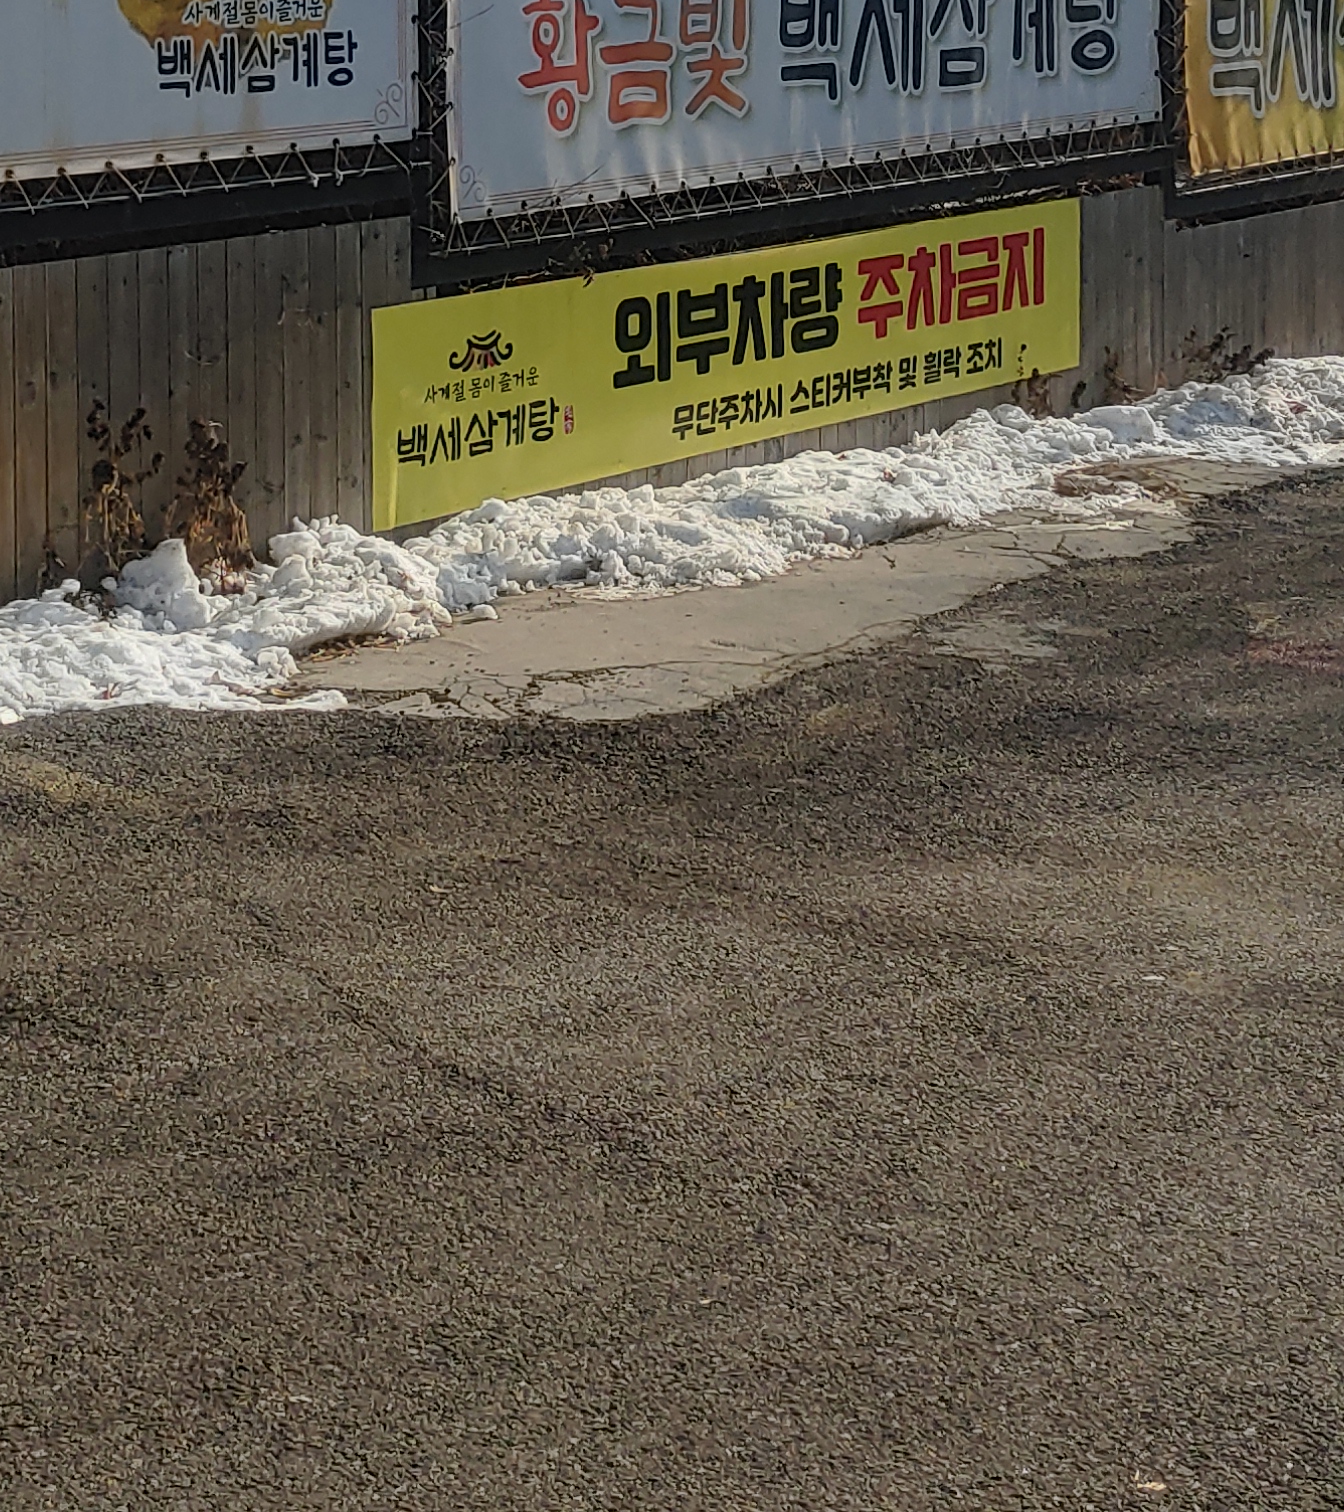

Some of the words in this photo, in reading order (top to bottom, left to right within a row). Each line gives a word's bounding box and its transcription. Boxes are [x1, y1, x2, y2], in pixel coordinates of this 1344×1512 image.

[157, 30, 358, 98] 백세삼계탕
[613, 262, 842, 389] 외부차량
[857, 227, 1046, 339] 주차금지
[398, 397, 559, 466] 백세삼계탕
[672, 384, 782, 440] 무단주차시
[790, 360, 892, 414] 스티커부착
[898, 356, 918, 390] 및
[924, 346, 961, 384] 휠락
[966, 338, 1001, 375] 조치
